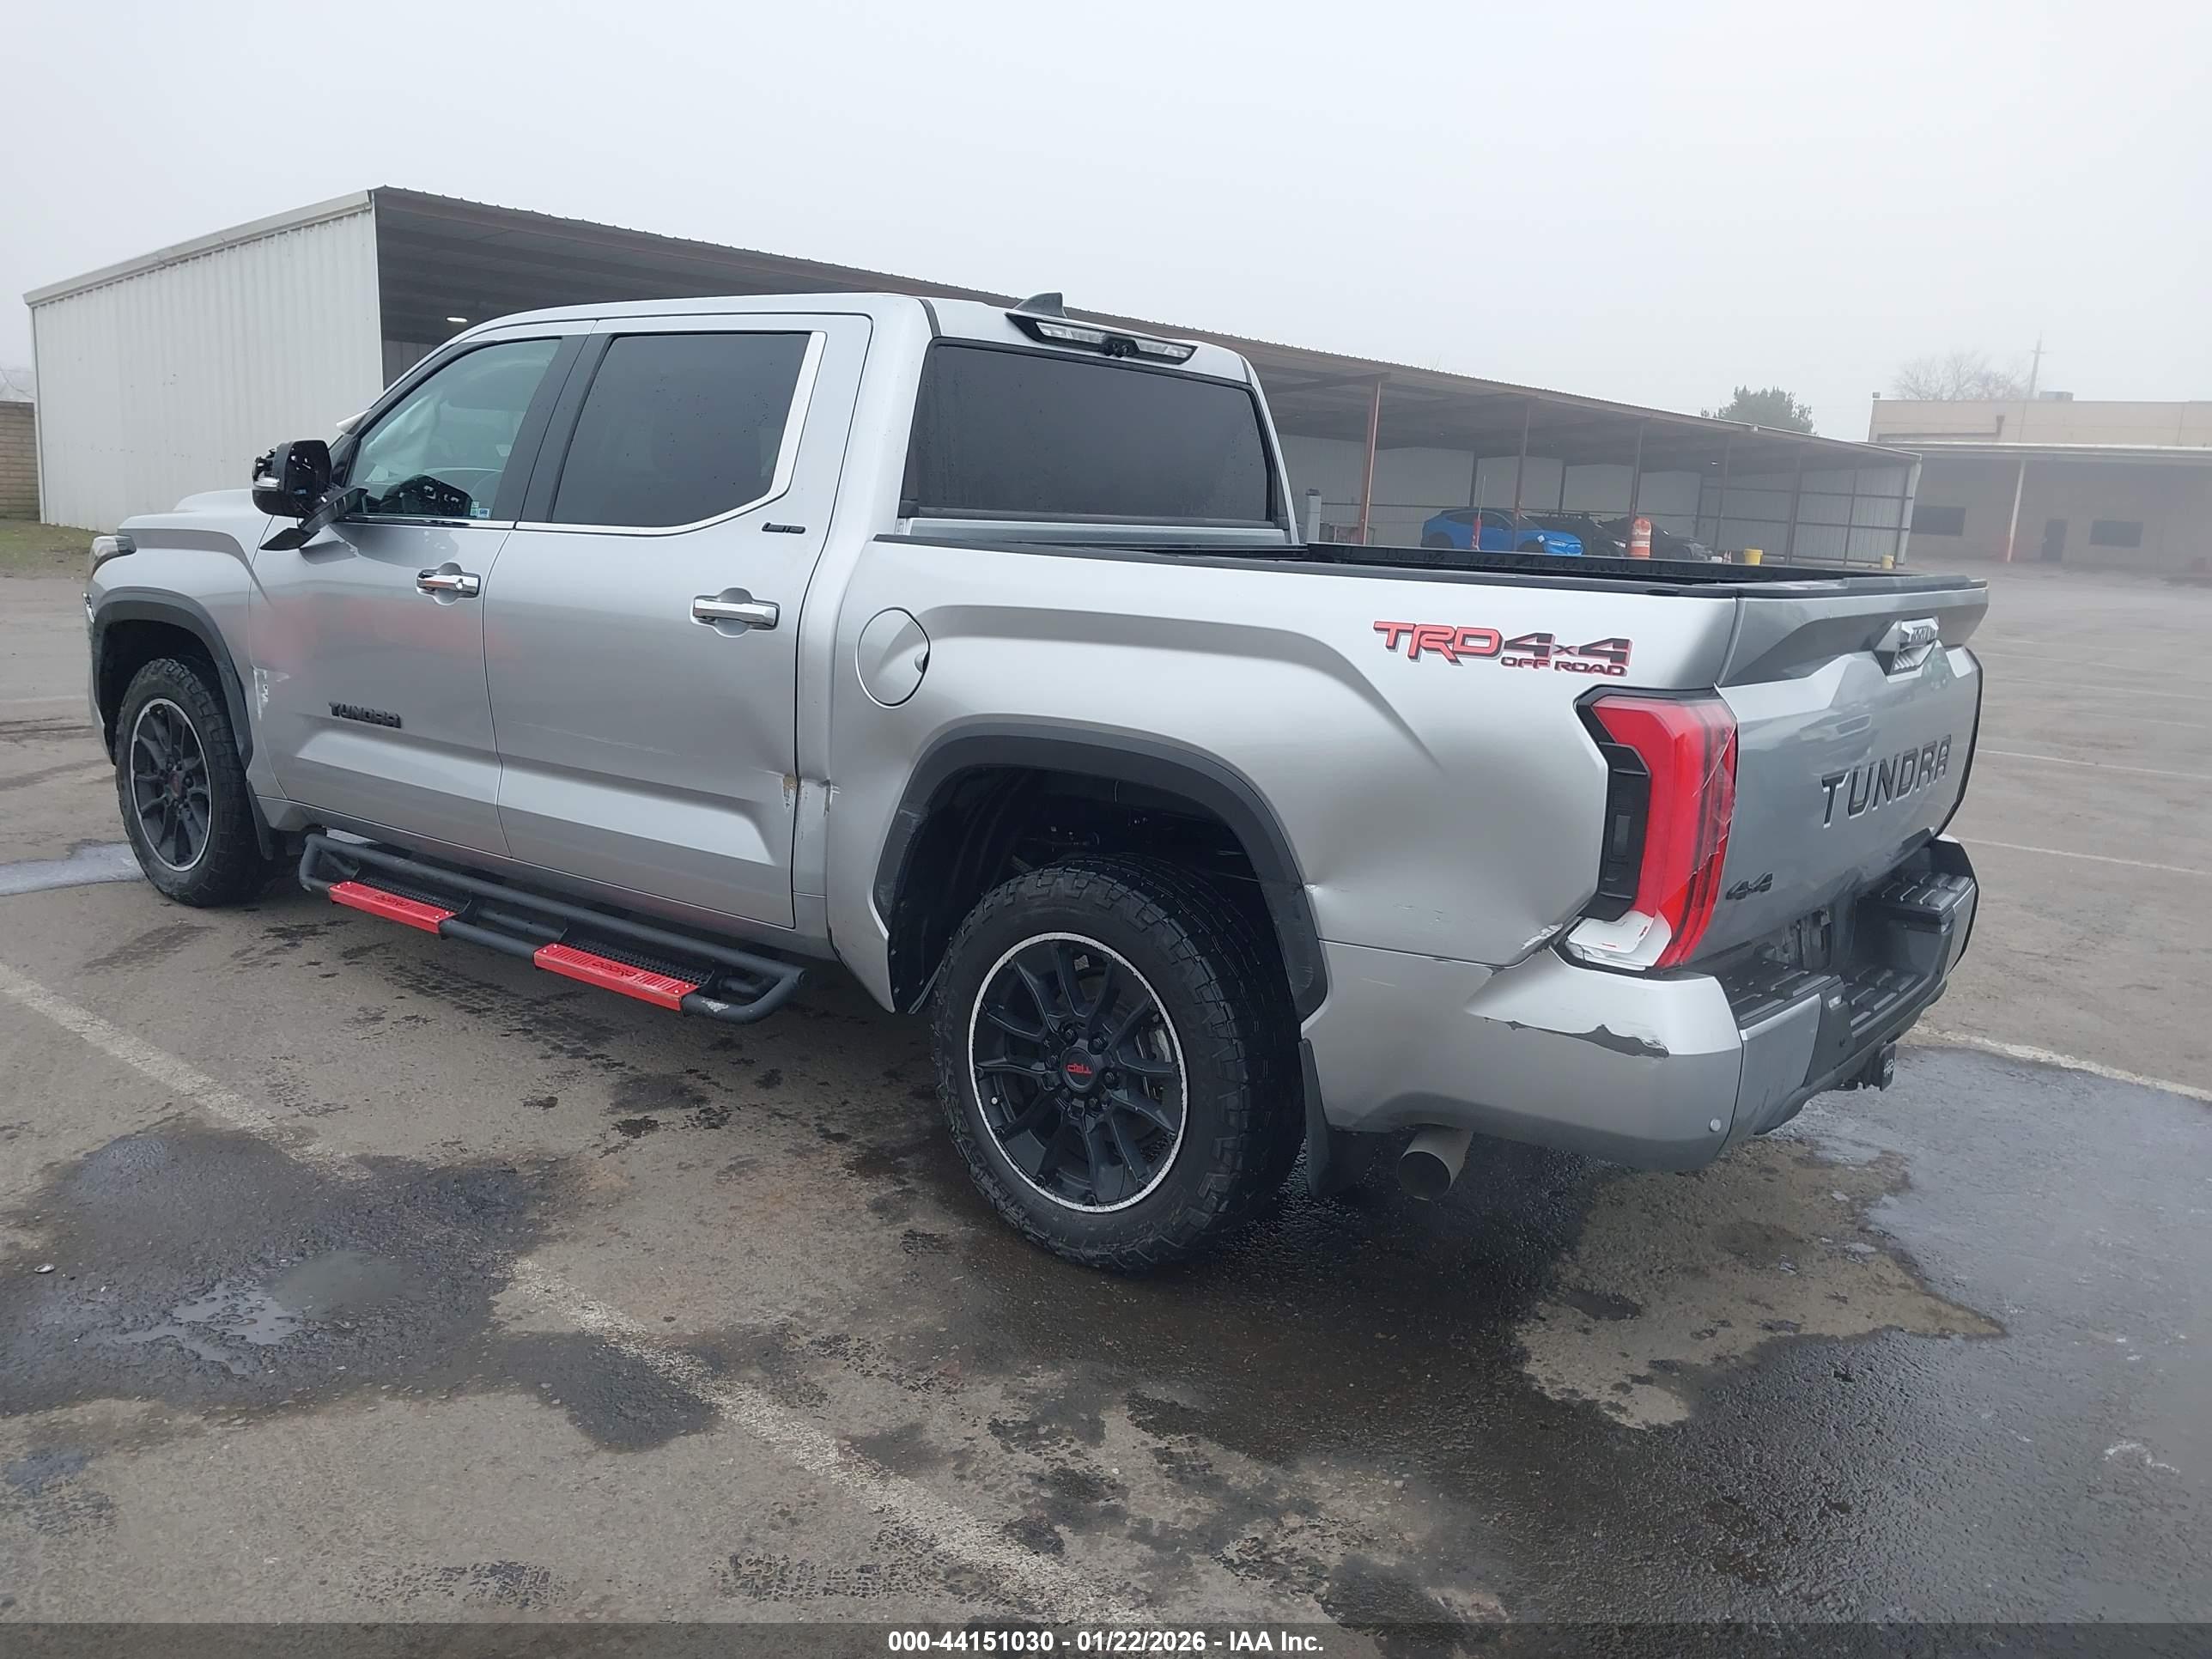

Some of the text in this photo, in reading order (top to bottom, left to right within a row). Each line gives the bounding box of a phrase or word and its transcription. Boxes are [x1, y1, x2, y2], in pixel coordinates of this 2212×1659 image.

[1373, 620, 1633, 667] TRD 4x4
[1501, 655, 1629, 678] OFF ROAD
[1820, 733, 1952, 829] TUNDRA
